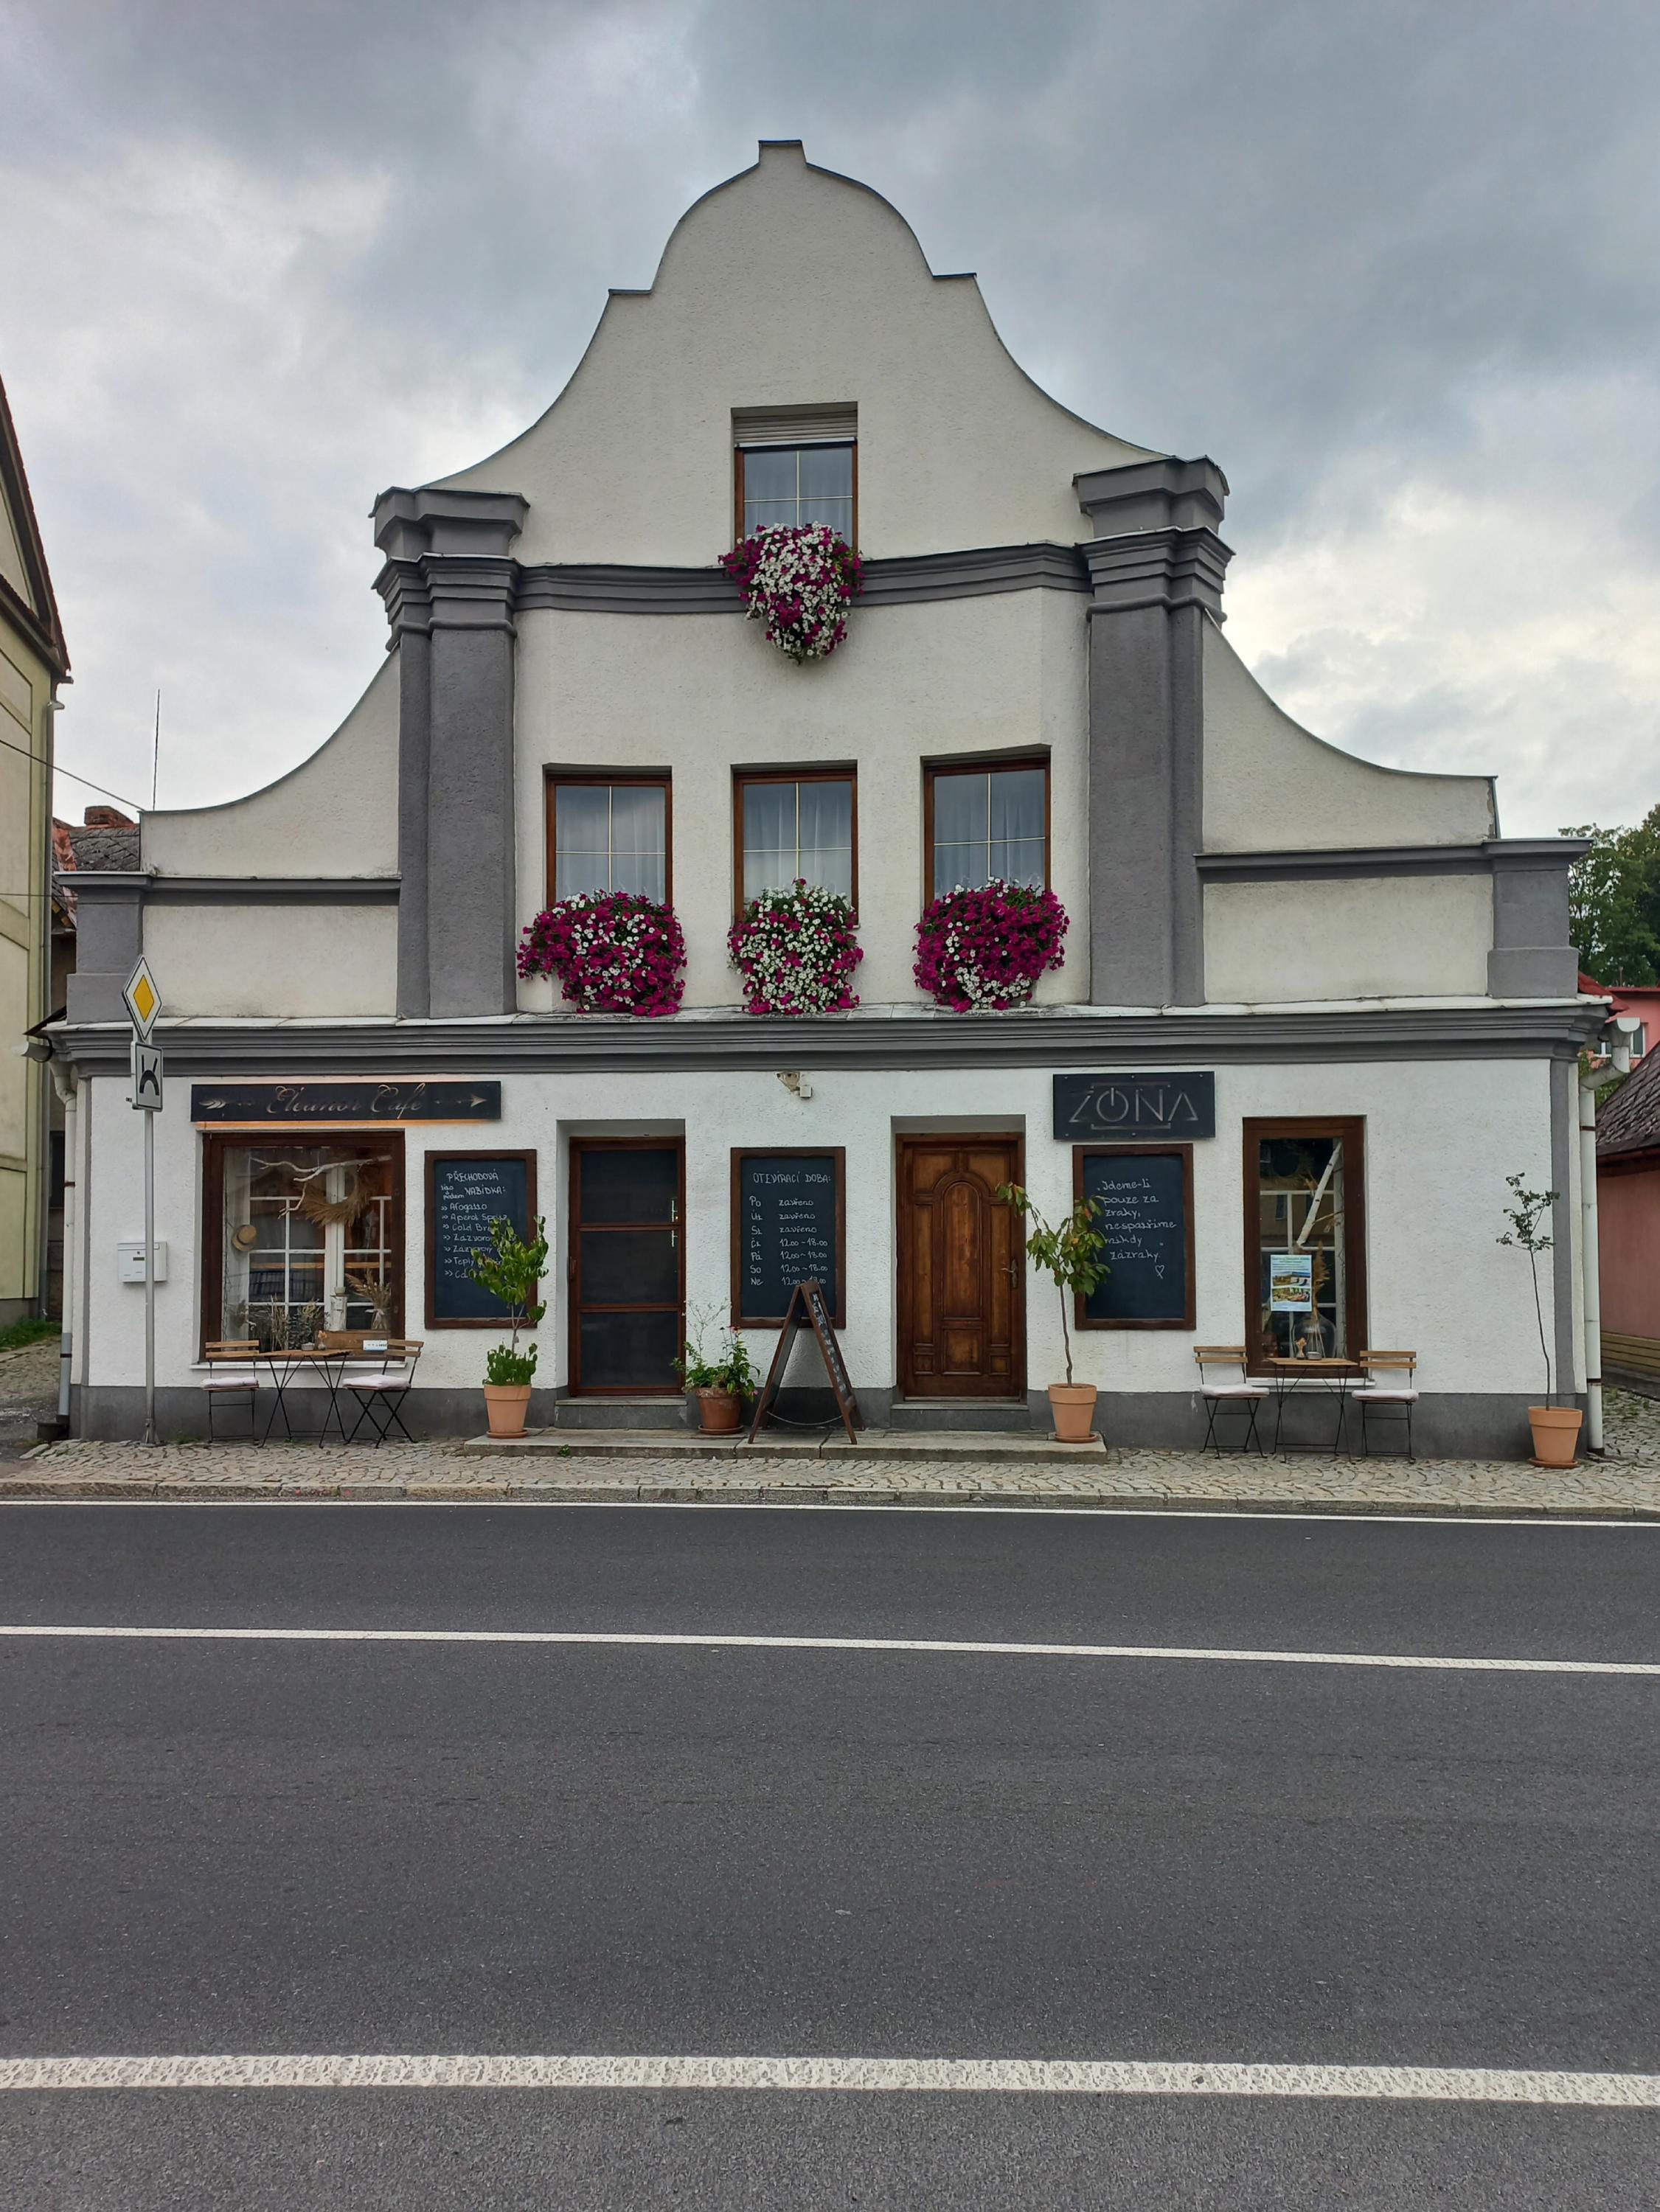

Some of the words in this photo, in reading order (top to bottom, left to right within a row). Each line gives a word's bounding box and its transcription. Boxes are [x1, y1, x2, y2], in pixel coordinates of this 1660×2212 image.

[266, 1085, 361, 1113] Eleanor
[371, 1082, 426, 1119] Café
[1069, 1087, 1198, 1123] ZONA
[446, 1169, 499, 1182] PŘECHODOVÁ
[753, 1170, 801, 1183] OTEVÍRACÍ
[805, 1173, 831, 1183] DOBA:
[465, 1184, 506, 1195] NABÍDKA:
[749, 1195, 762, 1207] Po
[779, 1197, 814, 1206] zavřeno
[1103, 1196, 1139, 1207] pouze
[1143, 1195, 1160, 1203] za
[451, 1213, 479, 1224] Aperol
[751, 1209, 763, 1221] Út
[778, 1211, 816, 1220] zavřeno
[1105, 1207, 1141, 1220] zraky,
[751, 1225, 763, 1235] St
[779, 1225, 818, 1234] zavřeno
[751, 1251, 763, 1262] Pá
[749, 1265, 762, 1274] So
[750, 1276, 764, 1286] Ne
